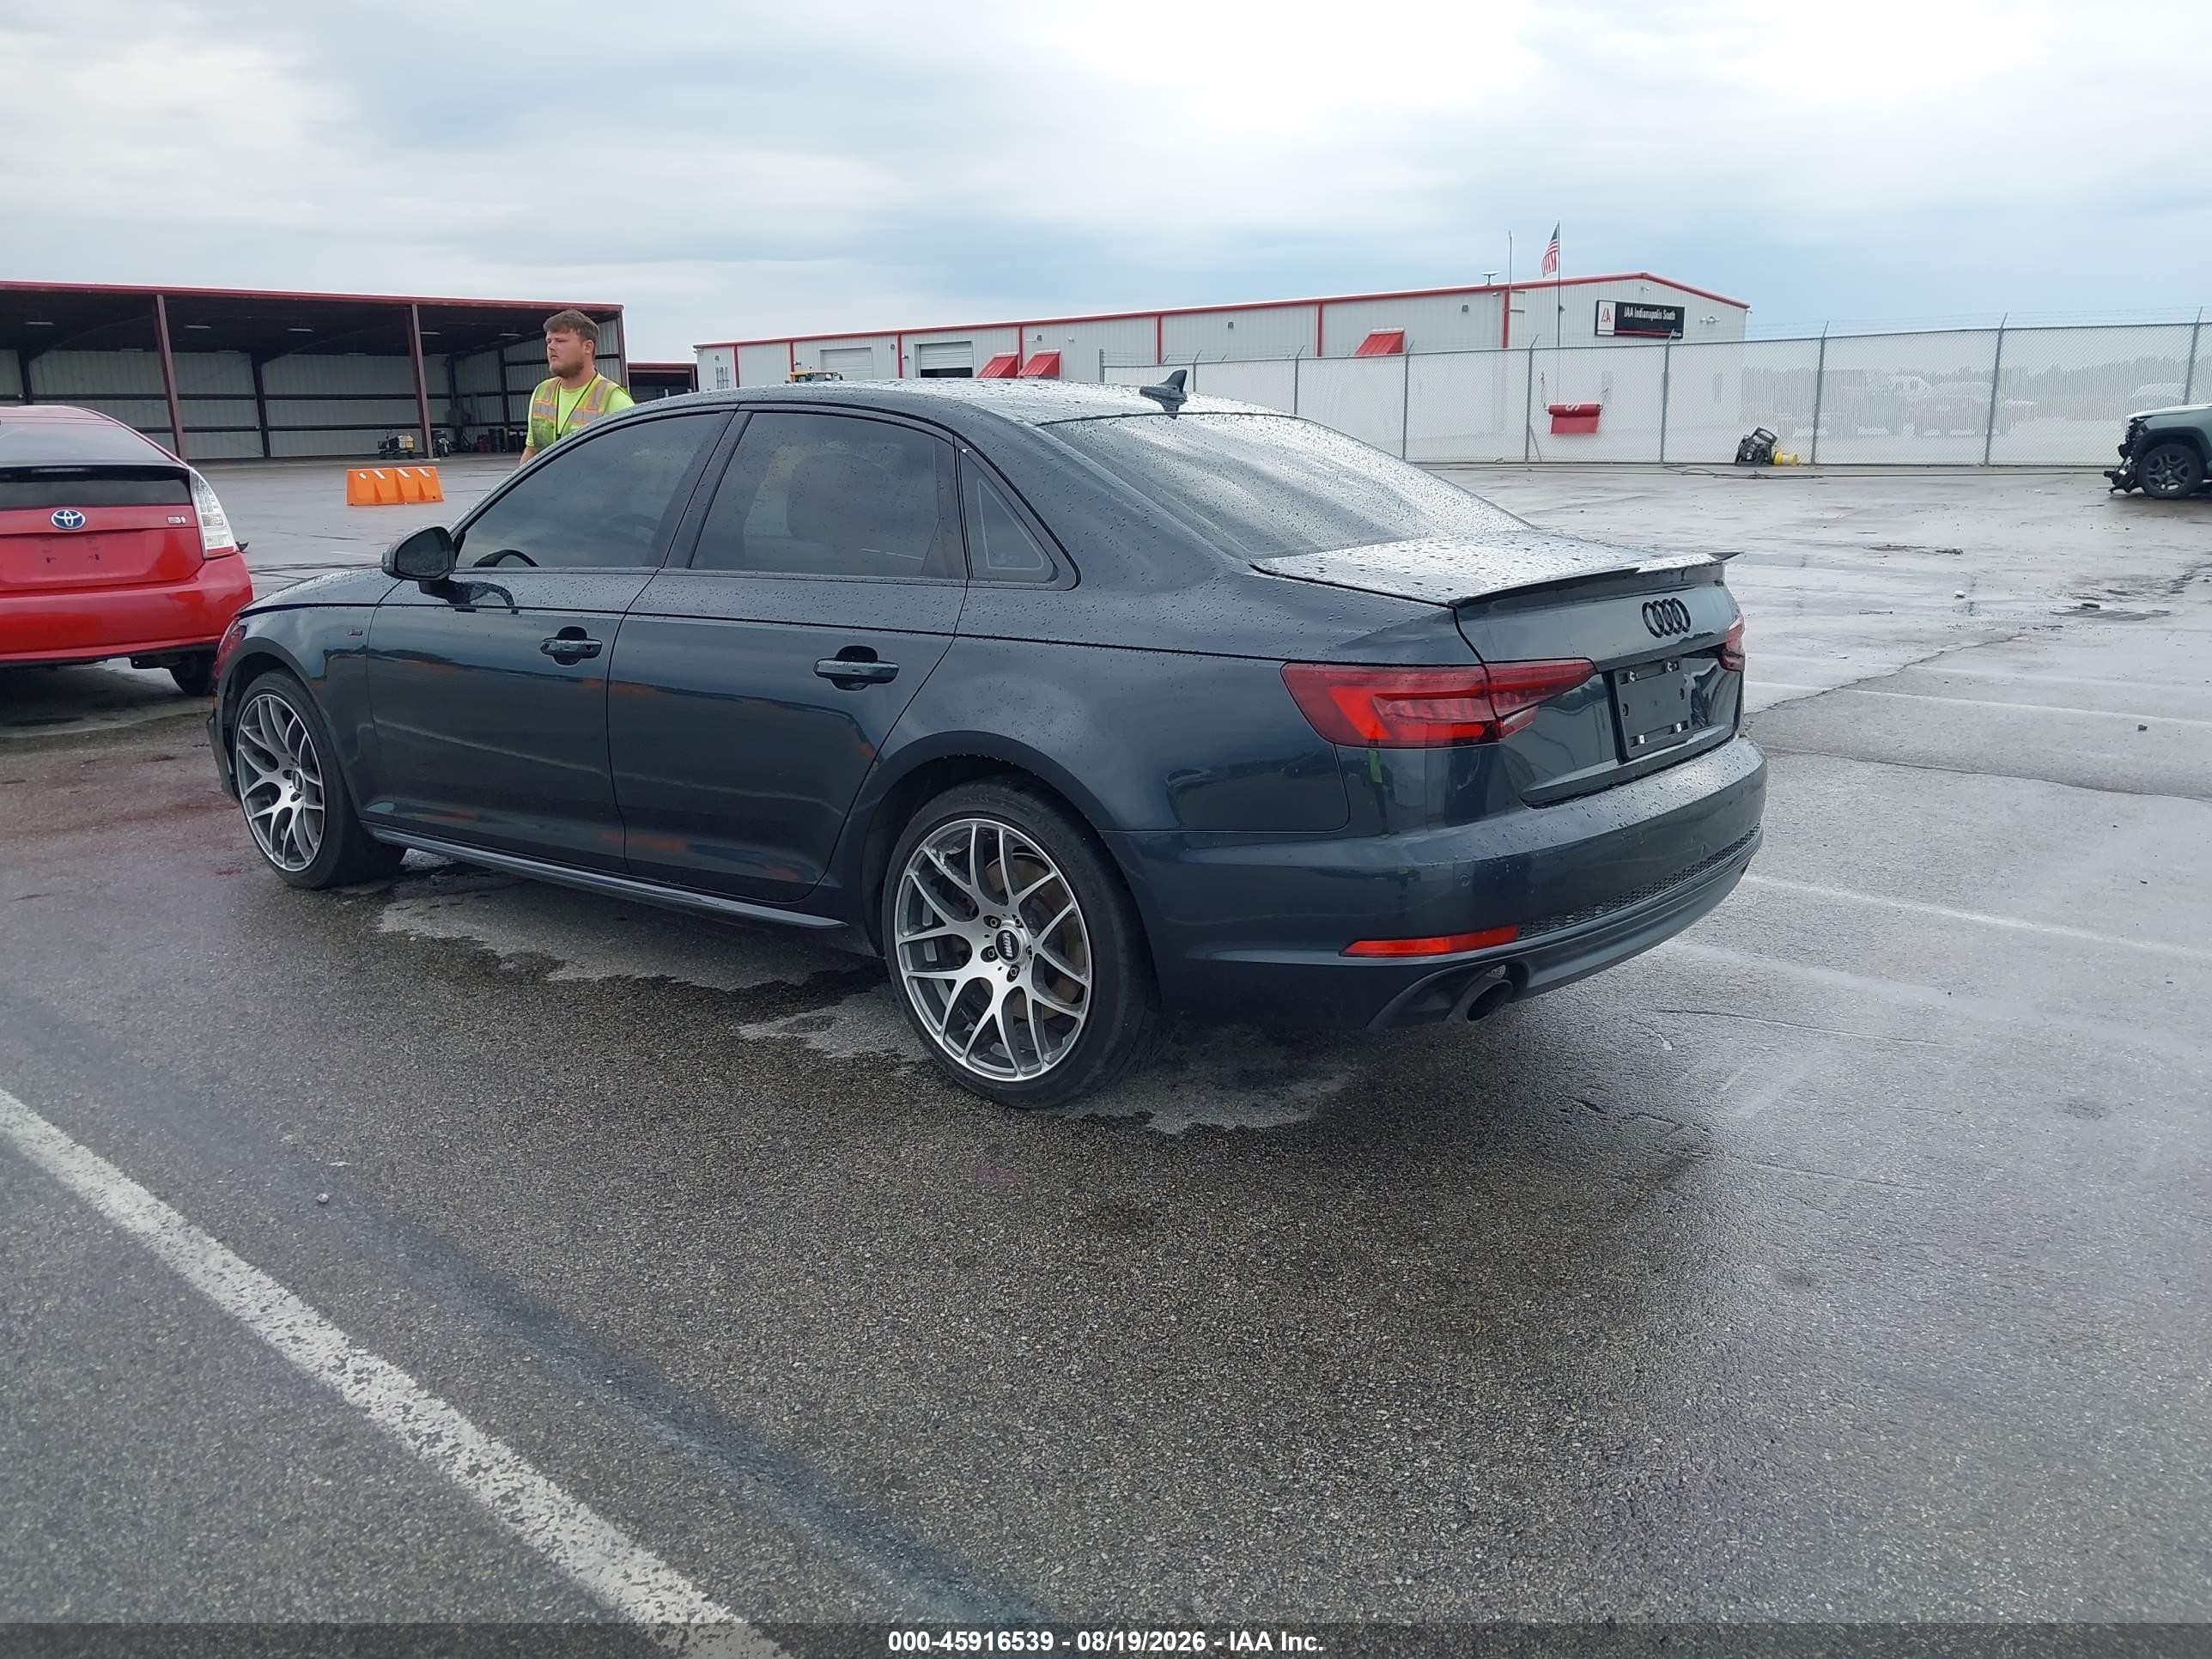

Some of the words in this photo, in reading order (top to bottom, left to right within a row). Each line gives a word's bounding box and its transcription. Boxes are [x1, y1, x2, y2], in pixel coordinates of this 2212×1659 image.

[1624, 307, 1633, 318] IAA
[1634, 307, 1662, 321] Indianapolis
[1662, 309, 1676, 320] South
